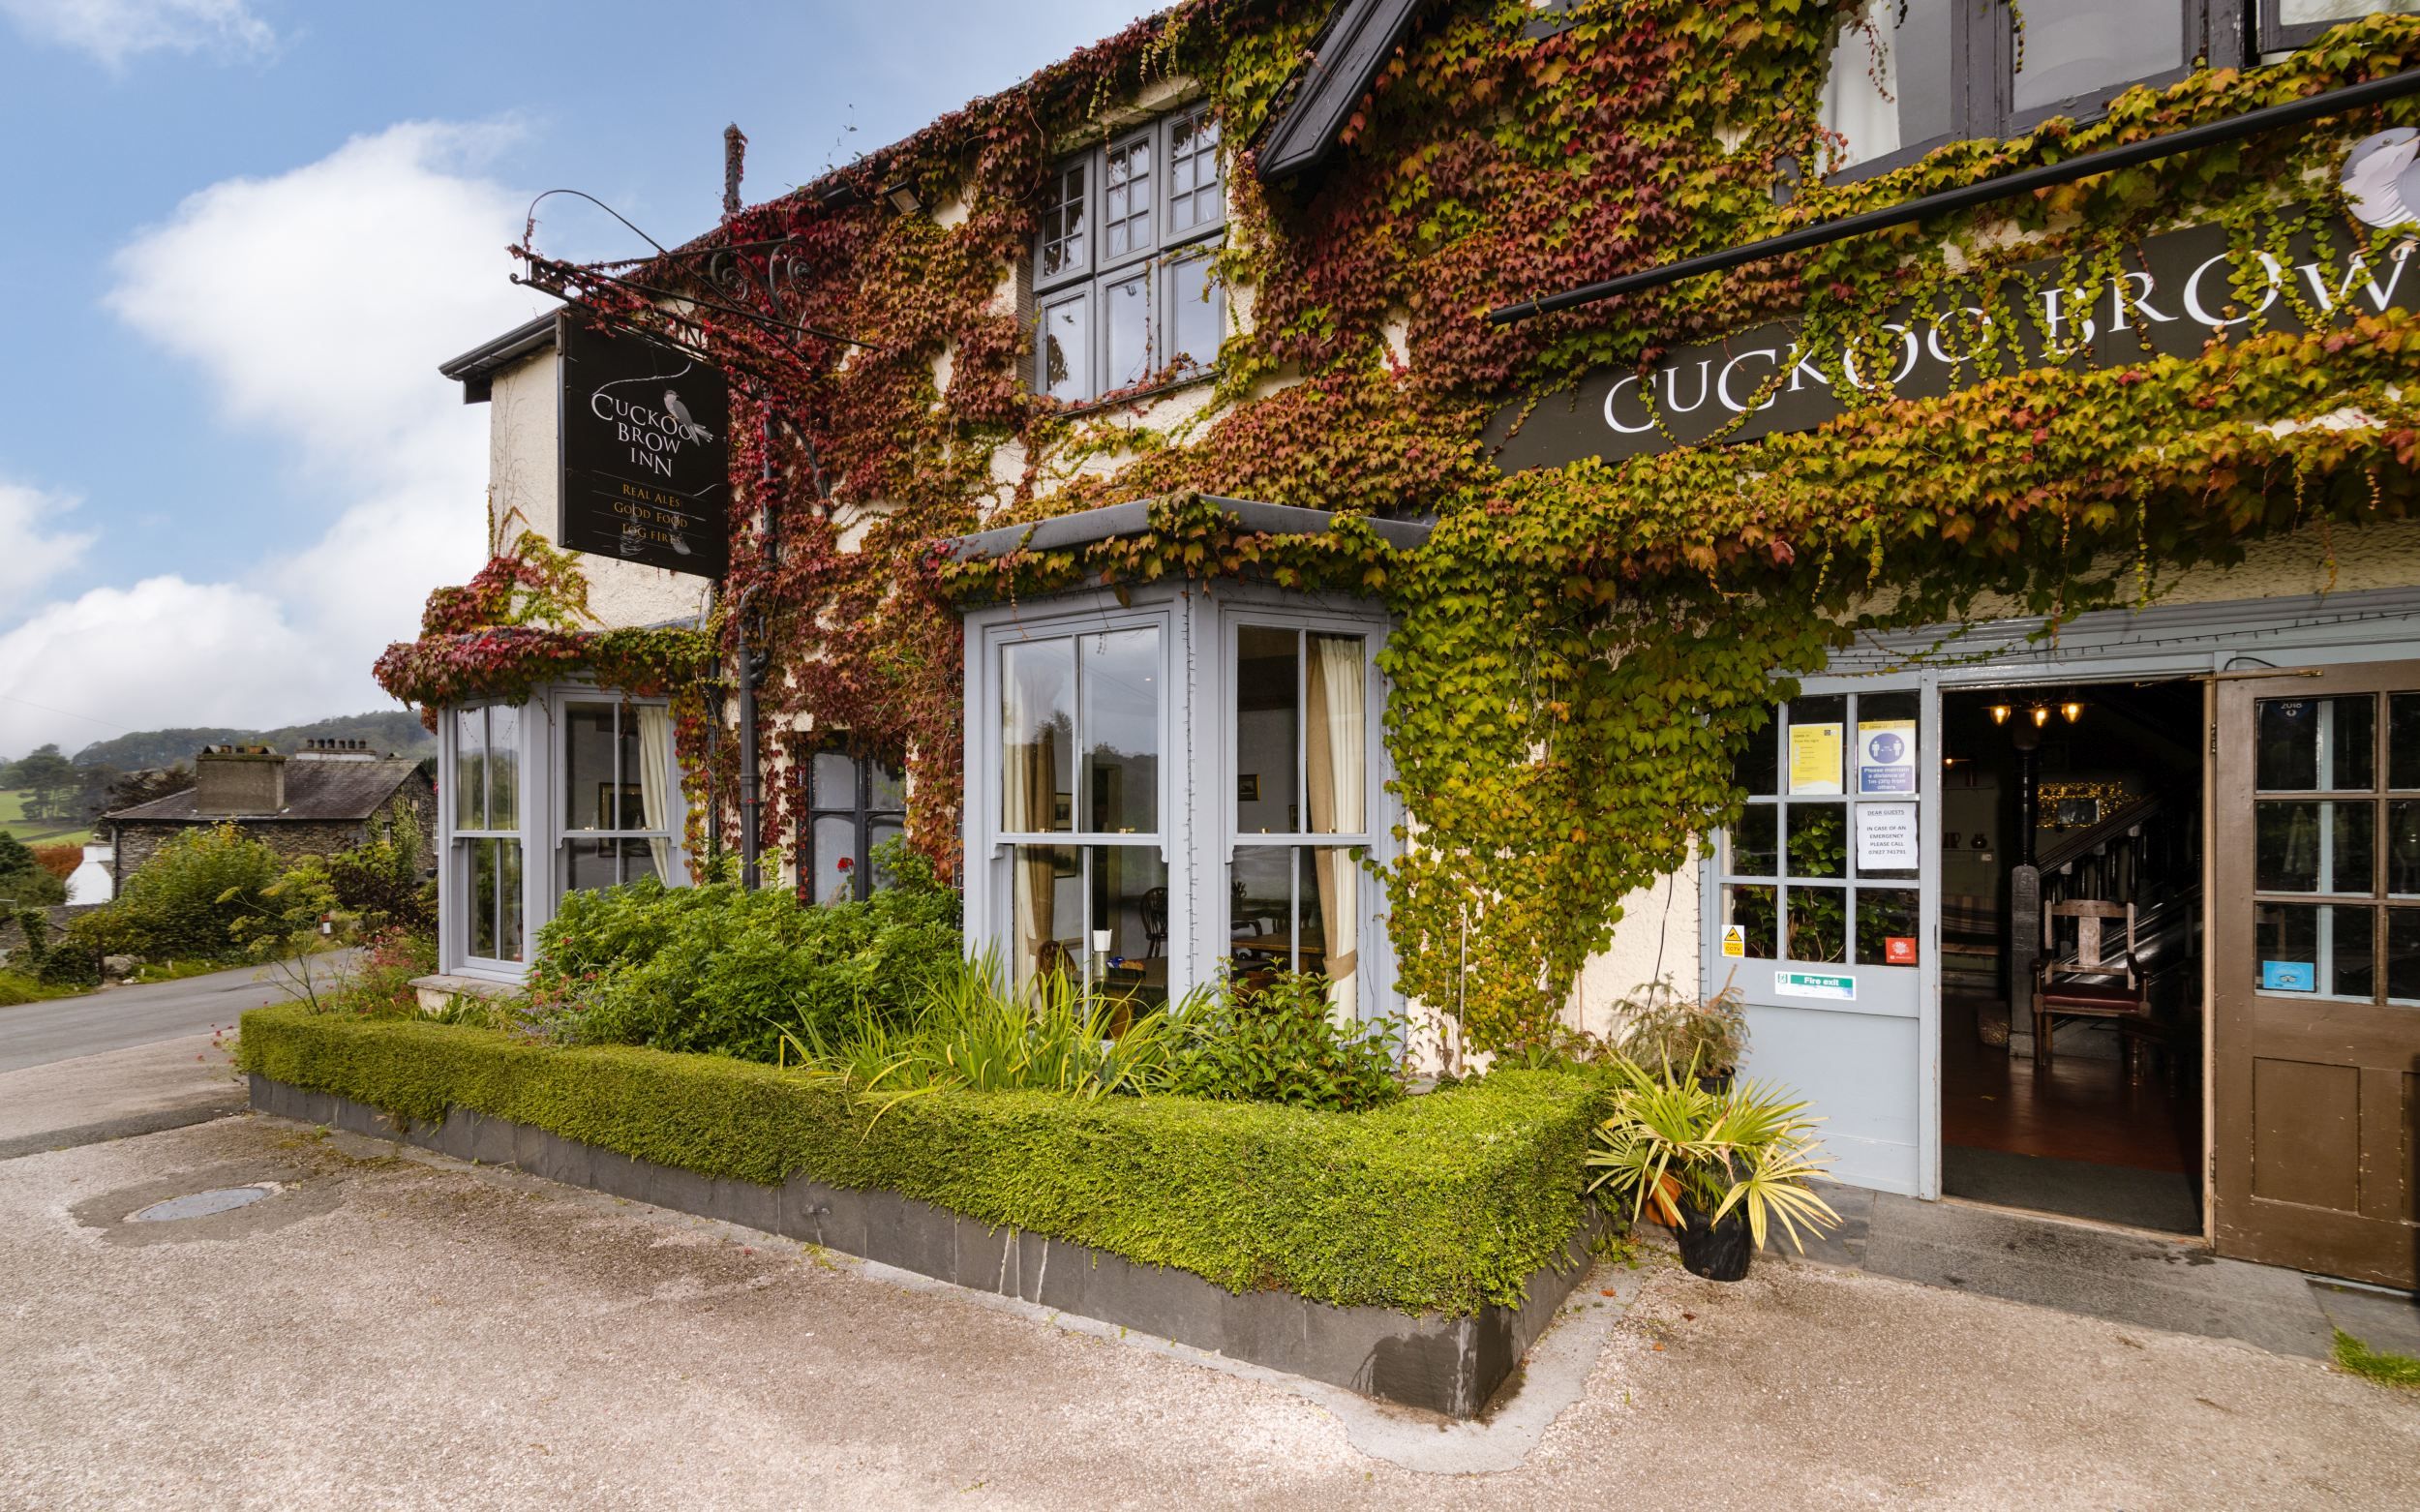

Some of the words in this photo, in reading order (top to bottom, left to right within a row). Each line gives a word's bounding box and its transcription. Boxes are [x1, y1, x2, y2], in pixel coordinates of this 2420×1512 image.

[1603, 306, 1992, 434] CUCKOO
[2037, 242, 2416, 359] BROW
[590, 393, 692, 440] CUCKOO
[617, 421, 681, 454] BROW
[630, 447, 673, 477] INN
[622, 483, 650, 499] REAL
[654, 494, 680, 507] ALES
[614, 501, 650, 519] GOOD
[656, 512, 688, 528] FOOD
[622, 524, 647, 538] LOG
[1803, 976, 1822, 985] Fire
[1823, 978, 1839, 986] exit
